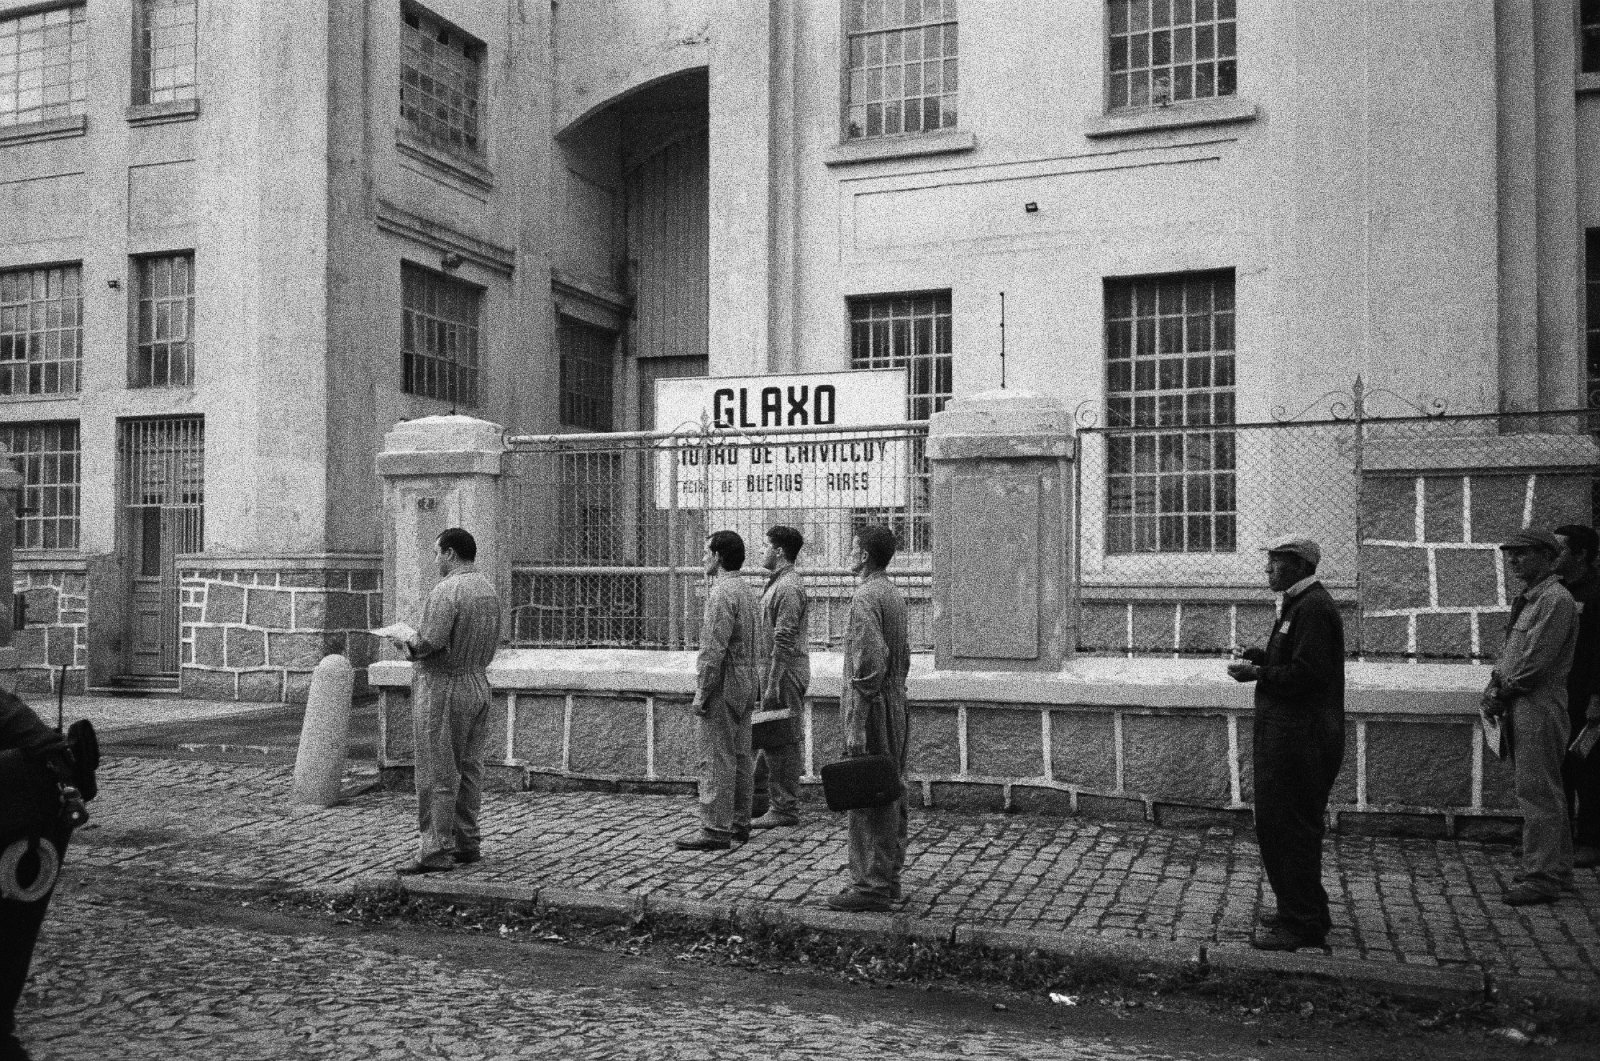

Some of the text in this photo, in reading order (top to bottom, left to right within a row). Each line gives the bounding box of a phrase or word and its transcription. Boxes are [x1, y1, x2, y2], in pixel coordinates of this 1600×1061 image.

[714, 385, 835, 428] GLAXO
[751, 442, 773, 464] DE
[747, 474, 802, 492] BUENOS
[826, 472, 869, 491] AIRES
